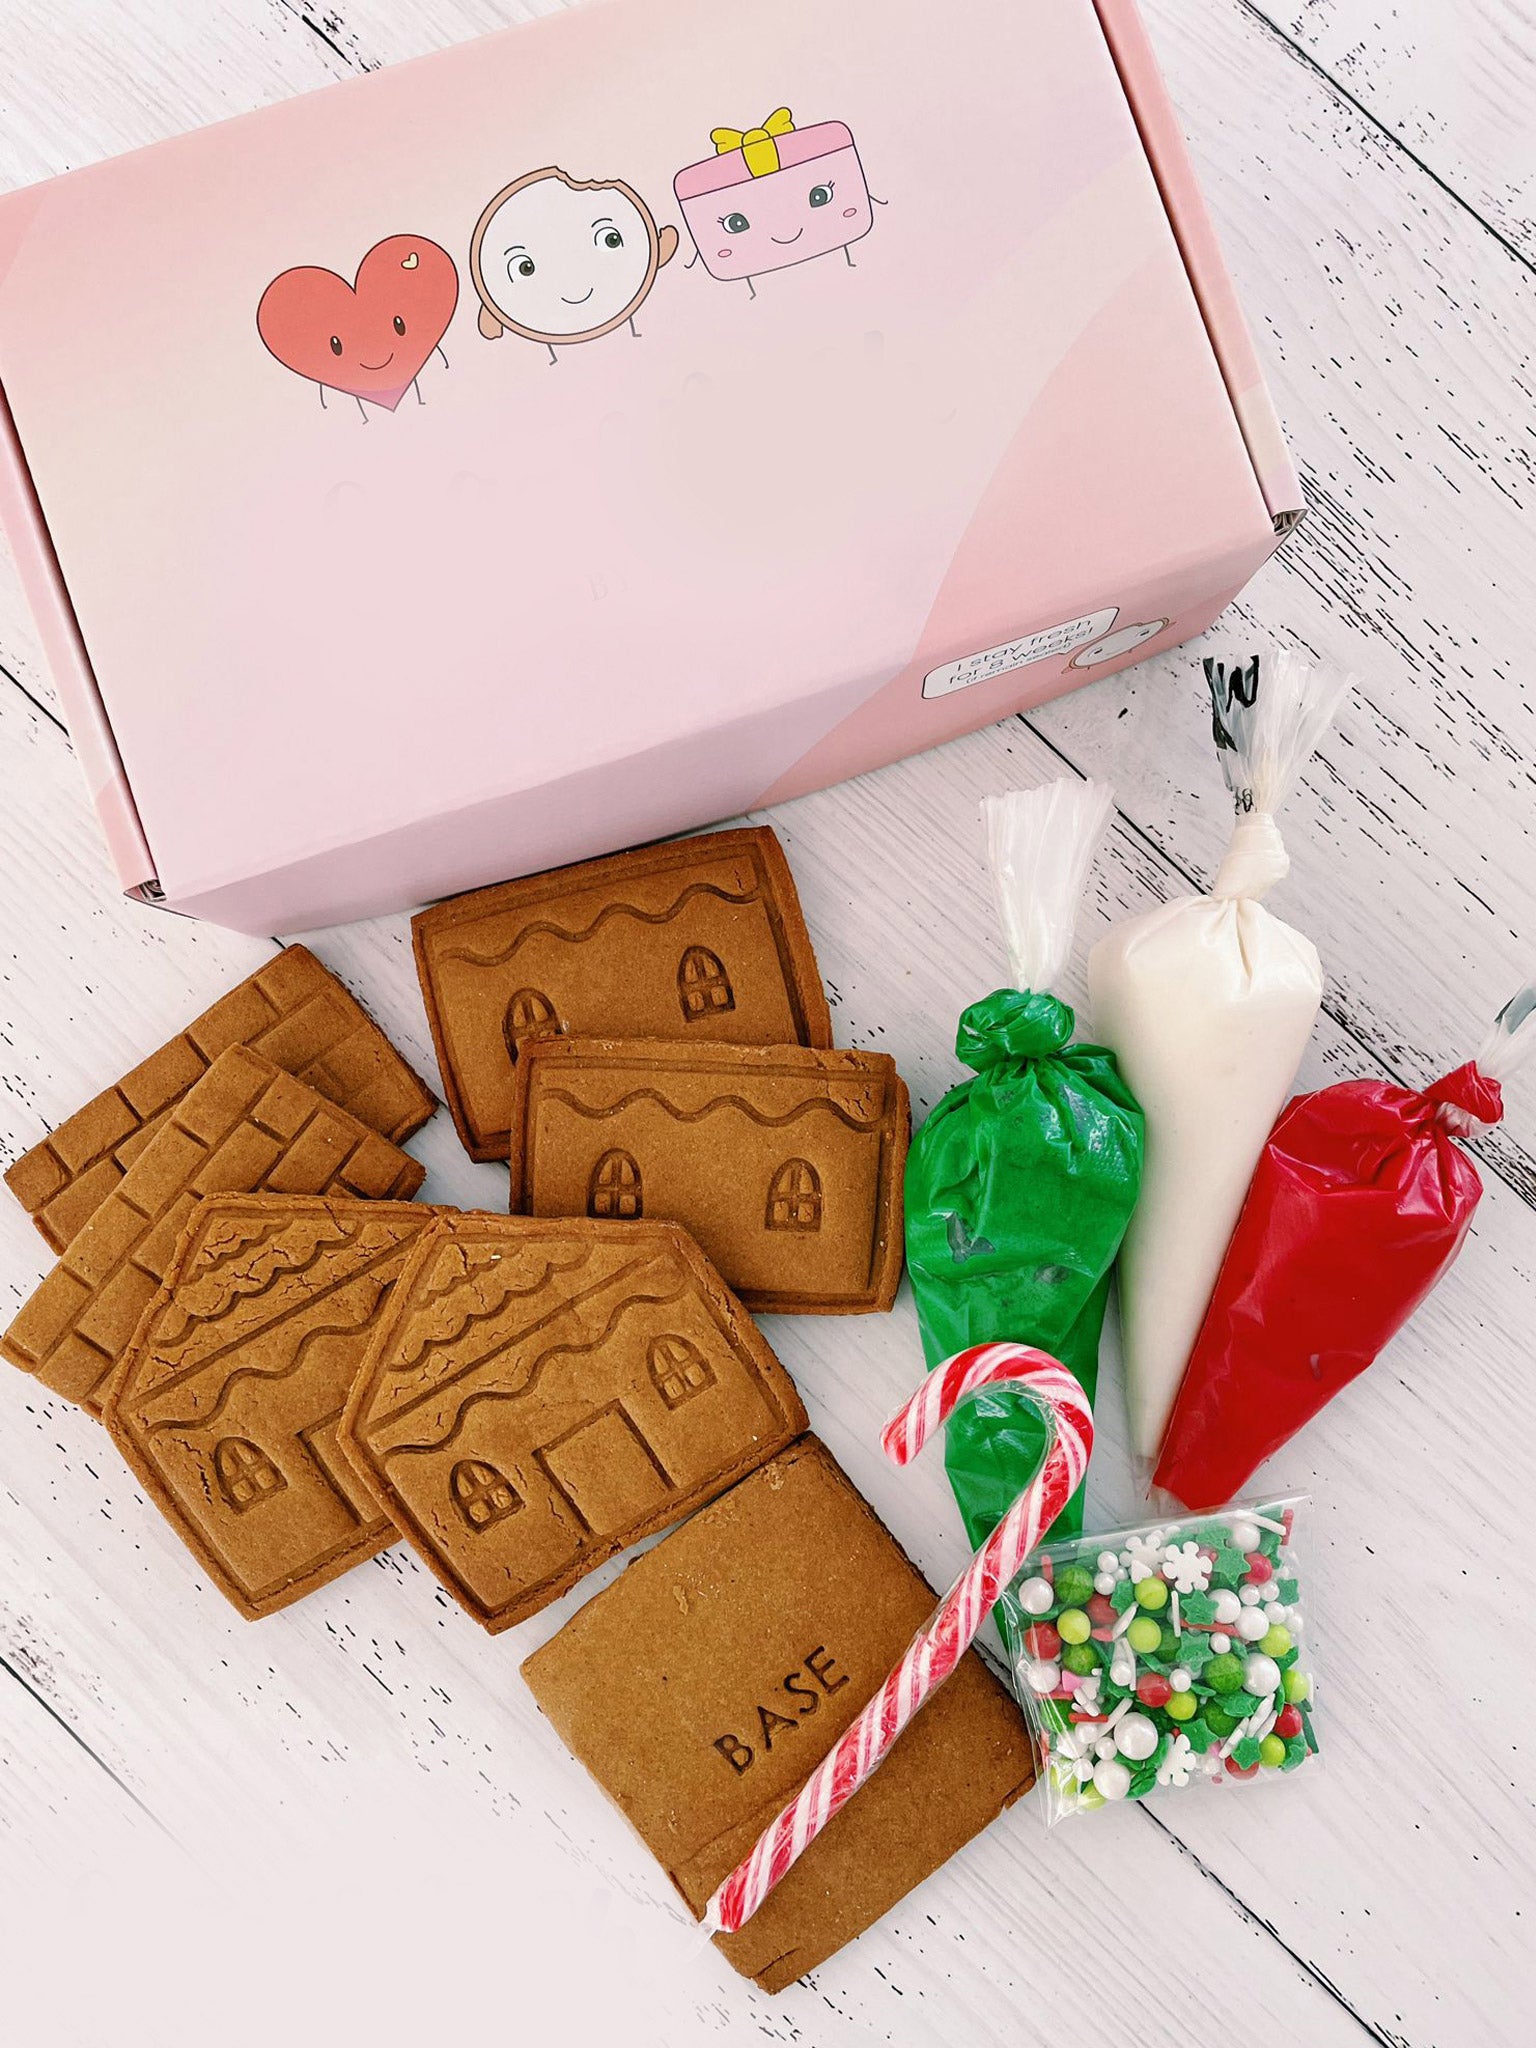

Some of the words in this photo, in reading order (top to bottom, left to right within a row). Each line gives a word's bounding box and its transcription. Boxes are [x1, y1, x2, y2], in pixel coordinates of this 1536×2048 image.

[950, 667, 980, 684] for
[989, 659, 1004, 670] 8
[1012, 627, 1093, 661] weeks!
[971, 643, 1023, 666] stay
[1030, 620, 1091, 646] fresh
[713, 1645, 850, 1776] BASE
